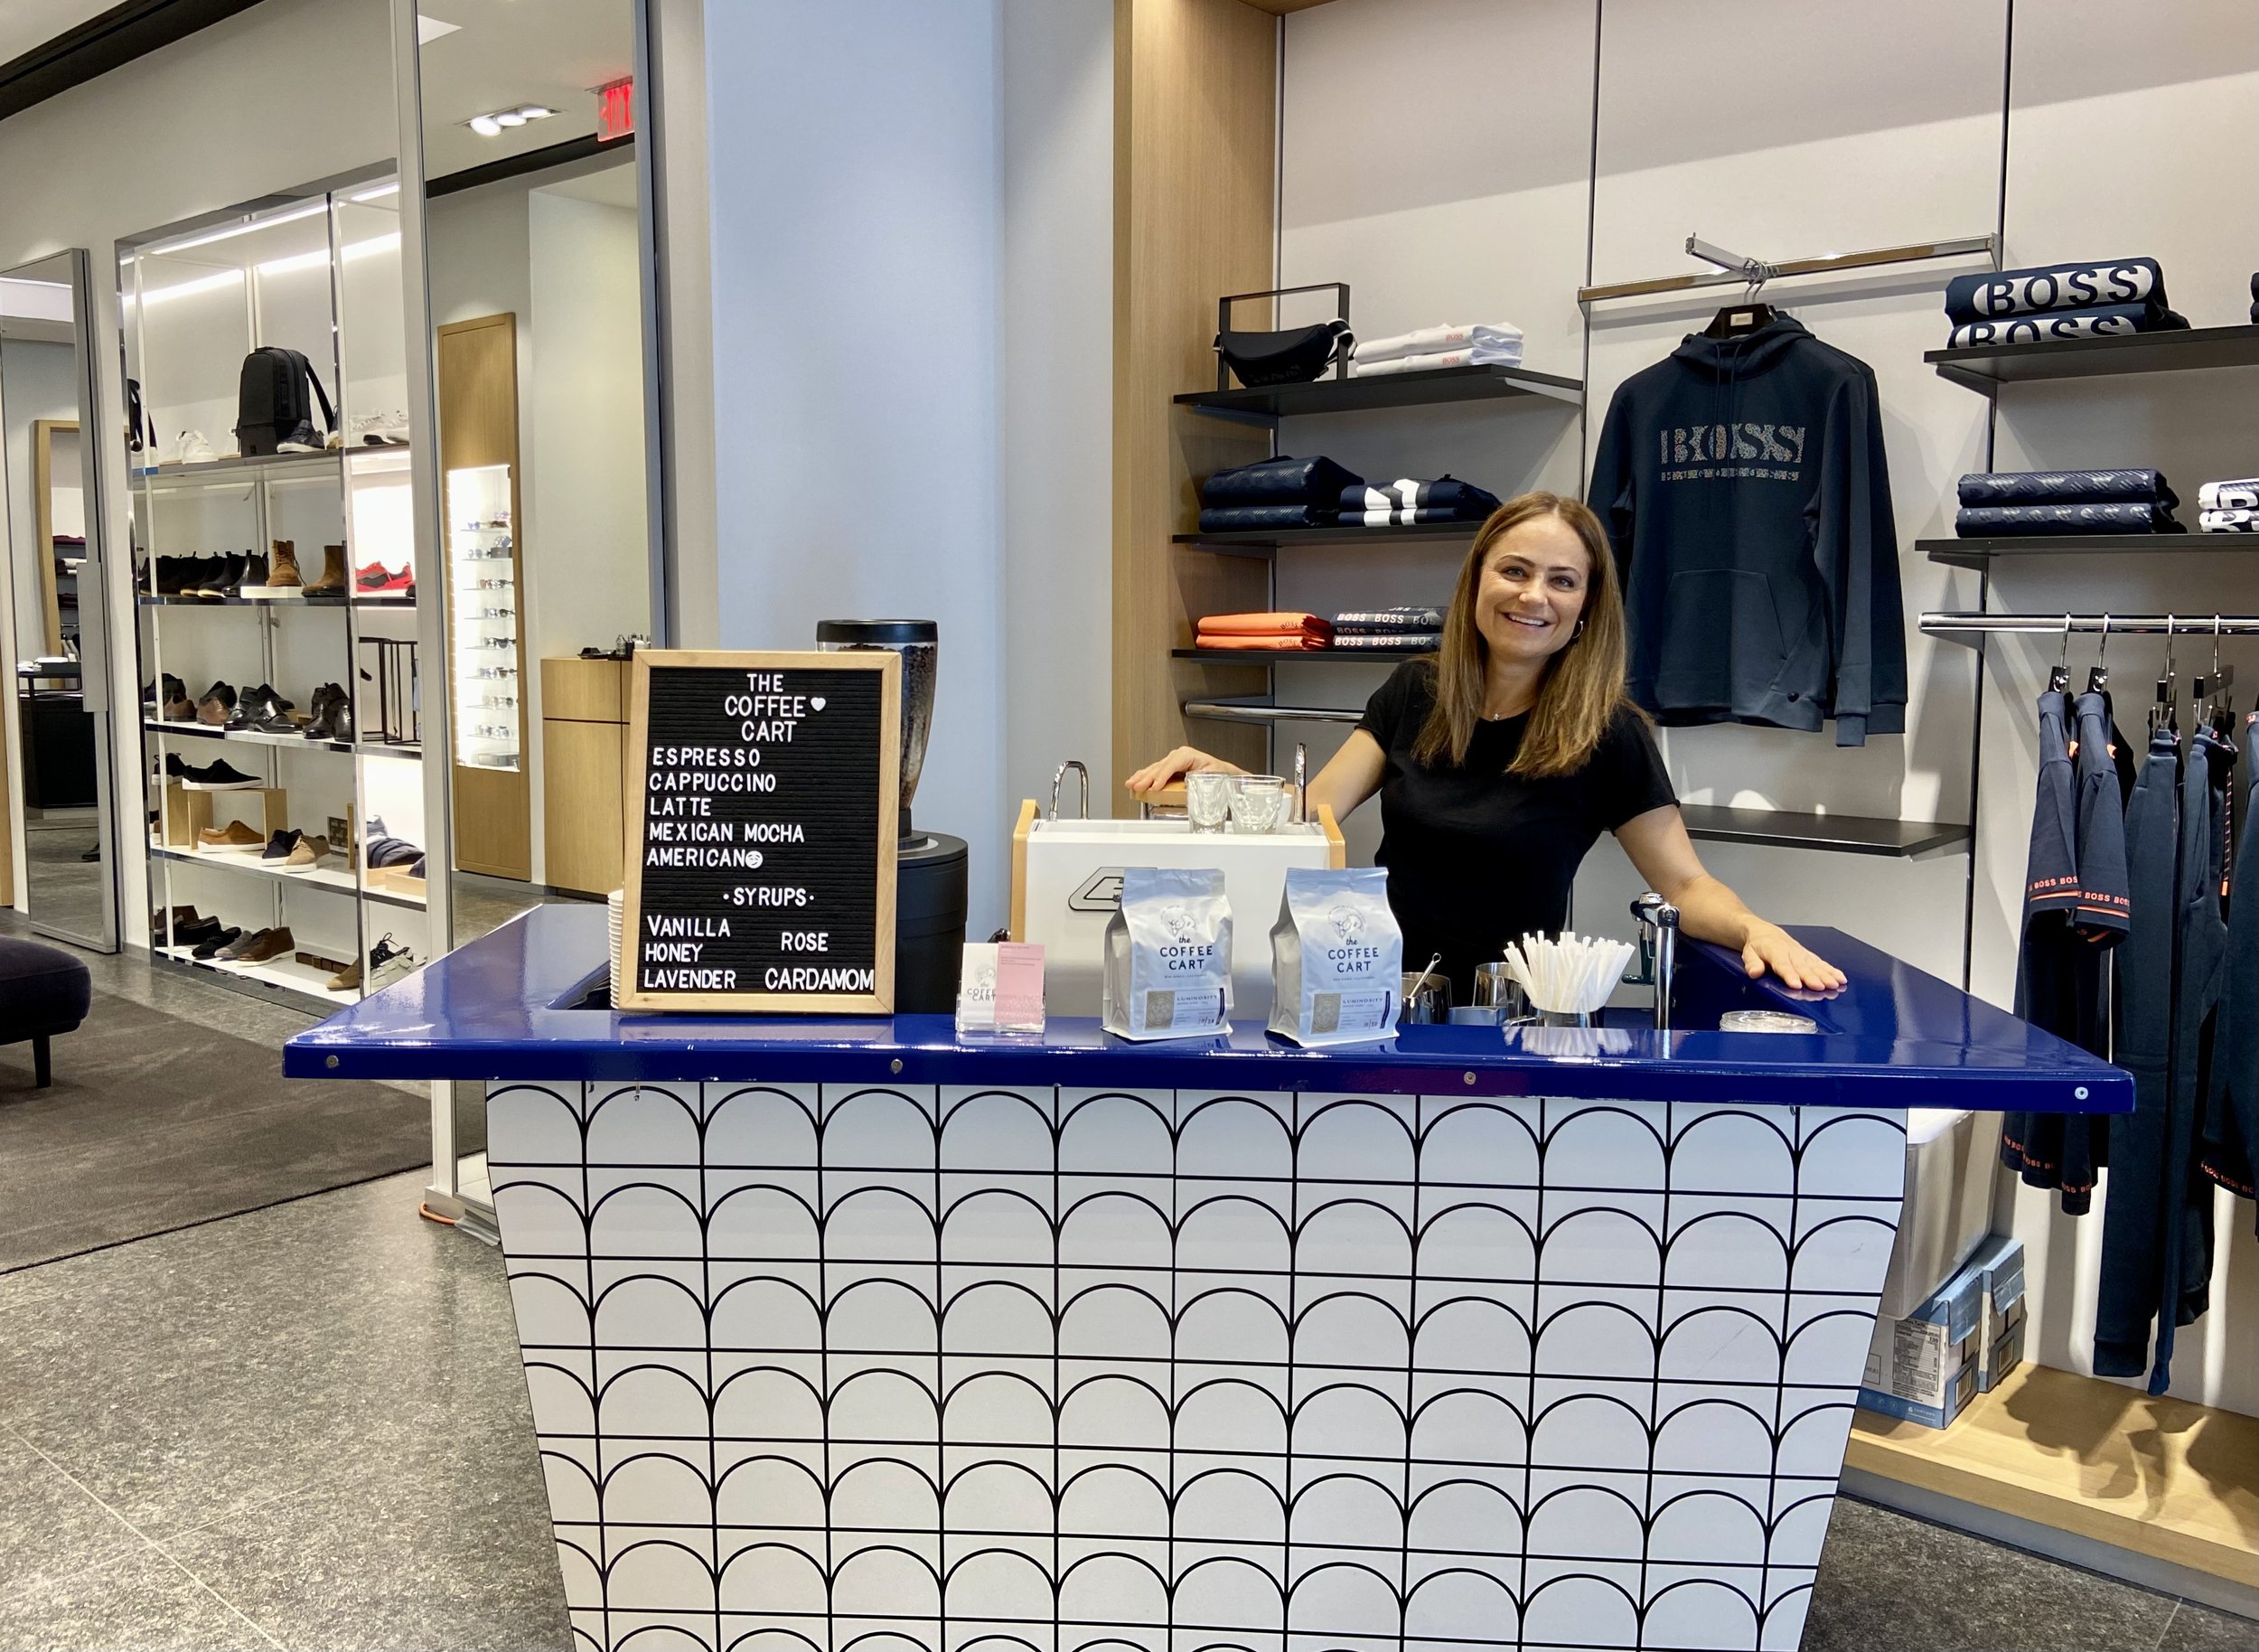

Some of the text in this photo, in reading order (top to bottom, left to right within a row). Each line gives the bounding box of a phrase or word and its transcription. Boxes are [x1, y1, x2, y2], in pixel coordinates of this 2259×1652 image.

[1979, 266, 2150, 315] BOSS
[1957, 316, 2137, 347] BOSS
[1660, 423, 1805, 464] BOSS
[1336, 614, 1367, 622] BOSS
[1374, 614, 1404, 624] BOSS
[1335, 637, 1364, 646] BOSS
[1372, 636, 1402, 645] BOSS
[746, 673, 783, 692] THE
[724, 695, 806, 718] COFFEE
[741, 720, 797, 743] CART
[652, 747, 761, 767] ESPRESSO
[649, 773, 776, 793] CAPPUCCINO
[650, 797, 712, 816] LATTE
[744, 823, 804, 843] MOCHA
[2034, 878, 2057, 889] BOSS
[2059, 876, 2078, 885] BOS
[2085, 891, 2111, 902] BOSS
[647, 915, 731, 938] VANILLA
[781, 932, 829, 952] ROSE
[1178, 934, 1192, 943] the
[1345, 935, 1358, 945] the
[645, 943, 703, 962] HONEY
[1159, 945, 1213, 958] COFFEE
[1327, 947, 1379, 960] COFFEE
[1168, 959, 1204, 971] CART
[1336, 961, 1372, 973] CART
[644, 968, 874, 990] LAVENDER CARDAMOM
[967, 988, 997, 996] COFFE
